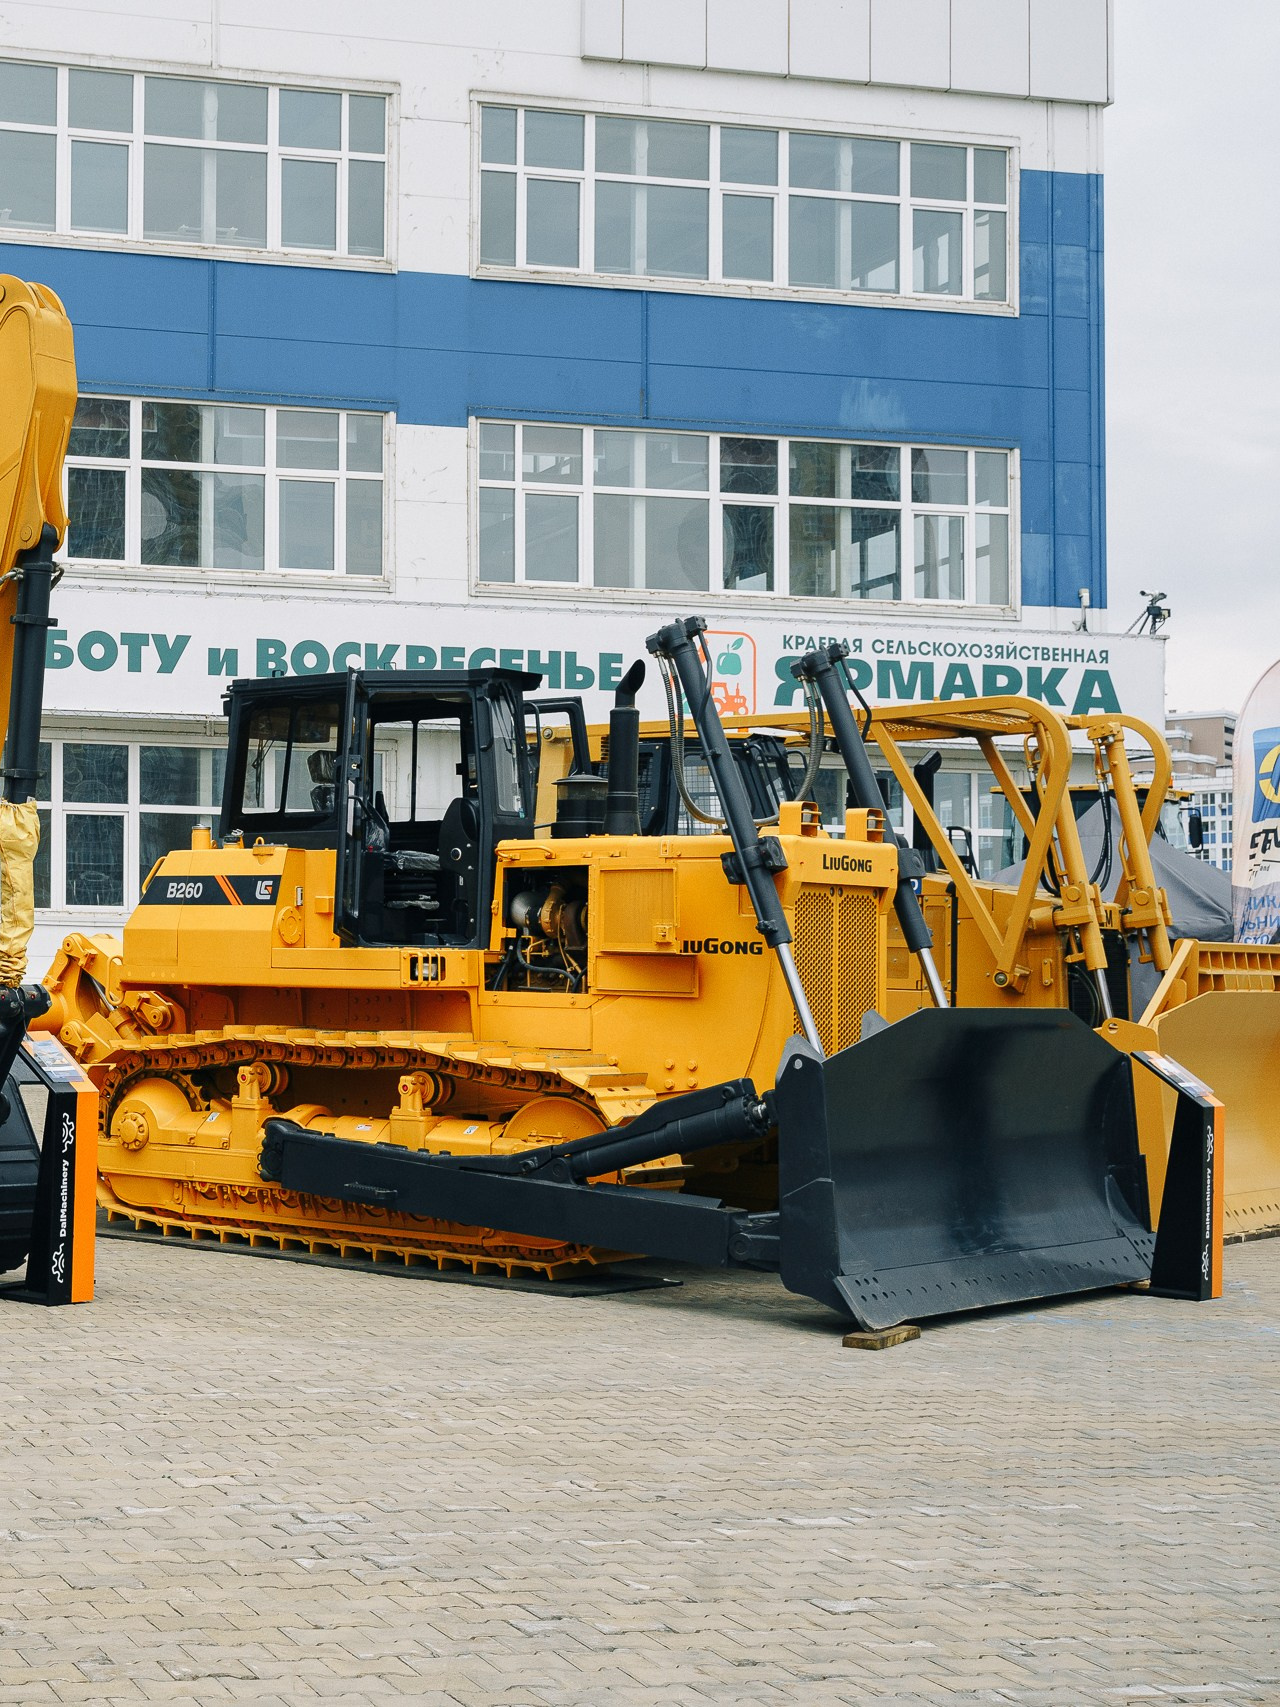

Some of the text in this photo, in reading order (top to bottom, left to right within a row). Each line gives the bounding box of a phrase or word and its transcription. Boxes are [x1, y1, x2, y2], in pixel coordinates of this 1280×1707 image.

[207, 647, 239, 677] и
[871, 639, 1109, 664] СЕЛЬСКОХОЗЯЙСТВЕННАЯ
[773, 655, 1122, 715] ЯРМАРКА
[166, 882, 203, 899] B260
[59, 1158, 70, 1238] DalMachinery
